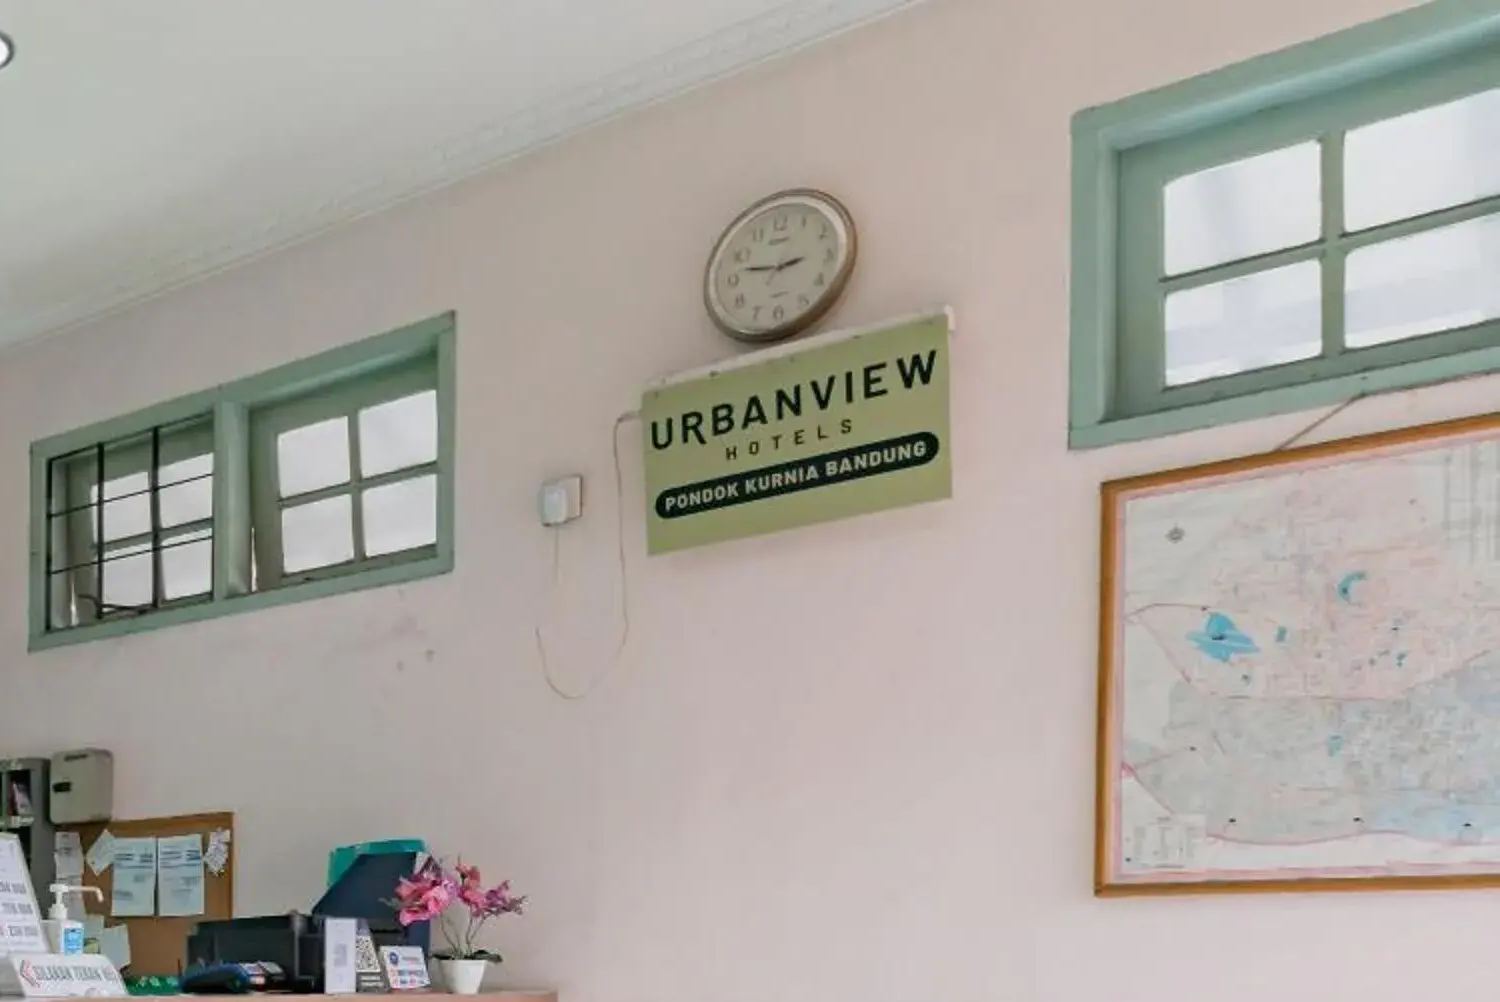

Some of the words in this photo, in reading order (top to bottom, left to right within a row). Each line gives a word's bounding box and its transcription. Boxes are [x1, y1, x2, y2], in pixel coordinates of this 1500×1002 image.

[651, 349, 937, 450] URBANVIEW
[664, 482, 739, 512] PONDOK
[744, 465, 819, 495] KURNIA
[825, 440, 927, 477] BANDUNG
[725, 419, 853, 461] HOTELS
